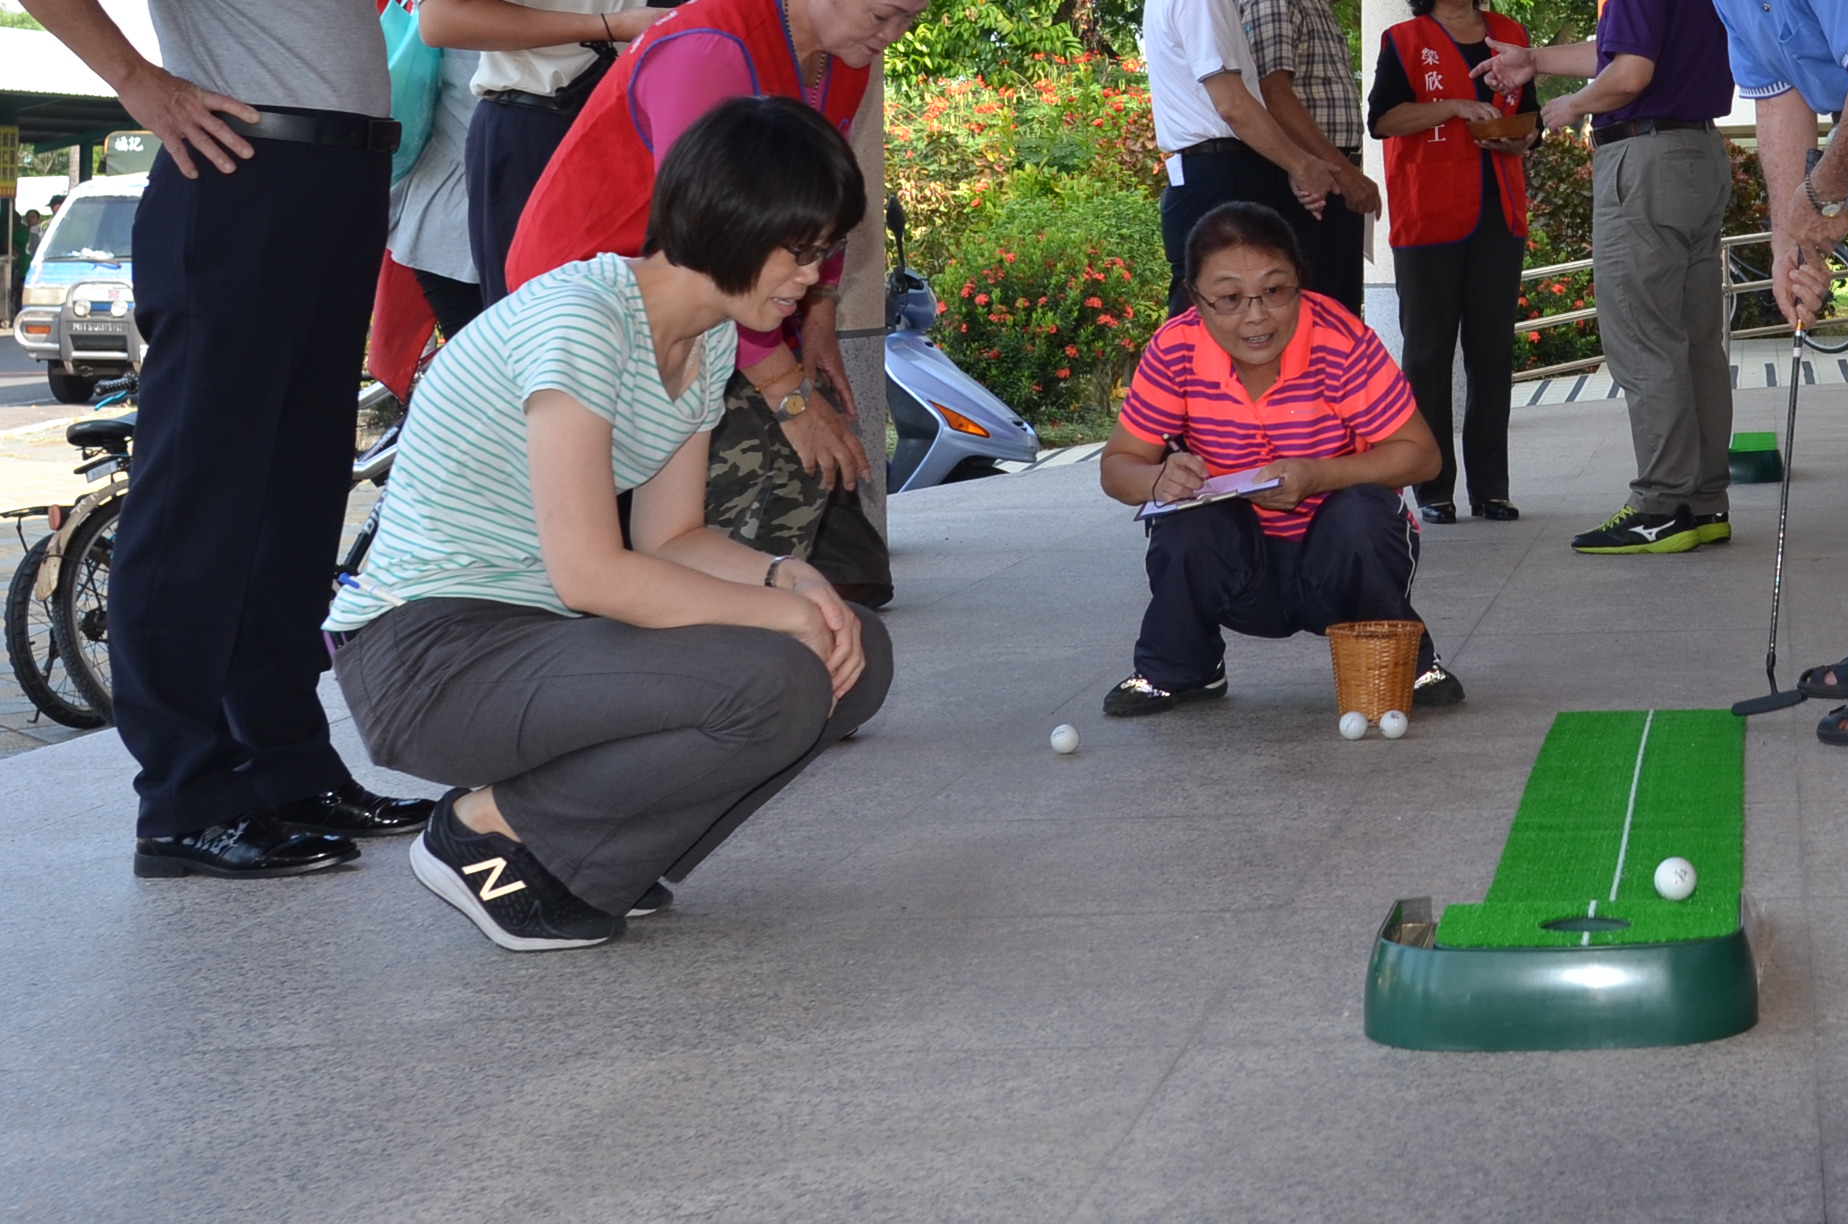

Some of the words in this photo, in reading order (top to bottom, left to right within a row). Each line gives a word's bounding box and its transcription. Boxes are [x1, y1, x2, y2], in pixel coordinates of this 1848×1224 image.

[1421, 47, 1447, 143] 榮欣工
[462, 857, 527, 902] N
